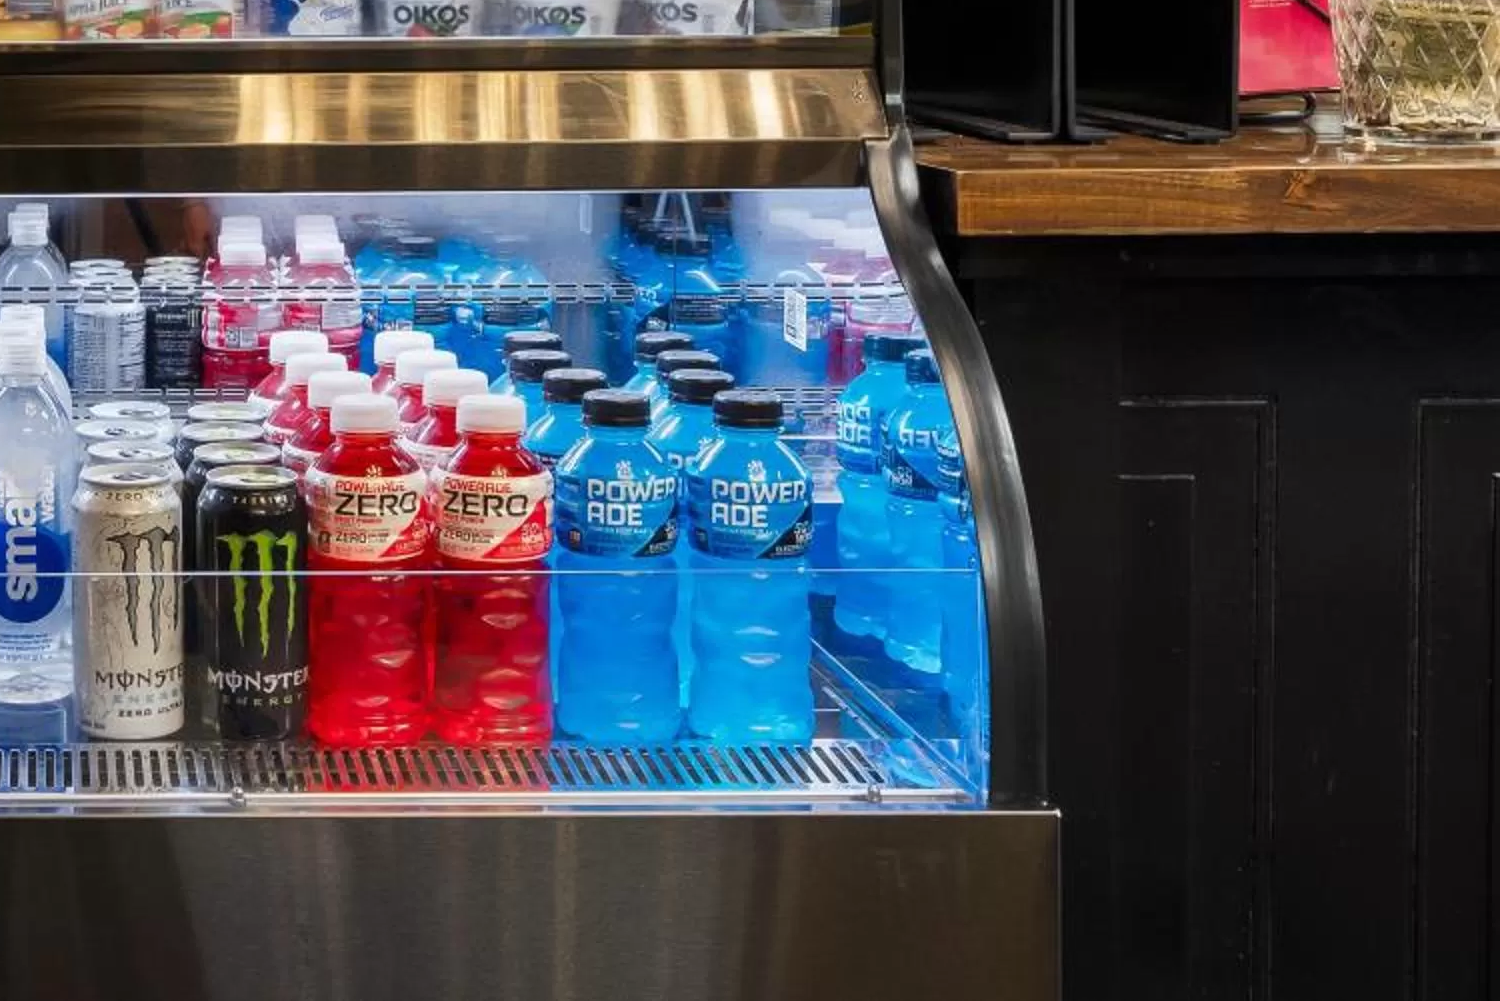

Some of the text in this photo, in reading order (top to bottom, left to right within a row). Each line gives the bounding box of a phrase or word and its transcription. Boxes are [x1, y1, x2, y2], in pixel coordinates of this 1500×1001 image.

[394, 3, 470, 26] OIKOS
[513, 5, 587, 26] OIKOS
[587, 475, 676, 502] POWER
[711, 478, 806, 504] POWER
[335, 490, 418, 517] ZERO
[442, 488, 529, 518] ZERO
[587, 500, 644, 527] ADE
[711, 502, 769, 529] ADE
[95, 662, 186, 692] MONSTE
